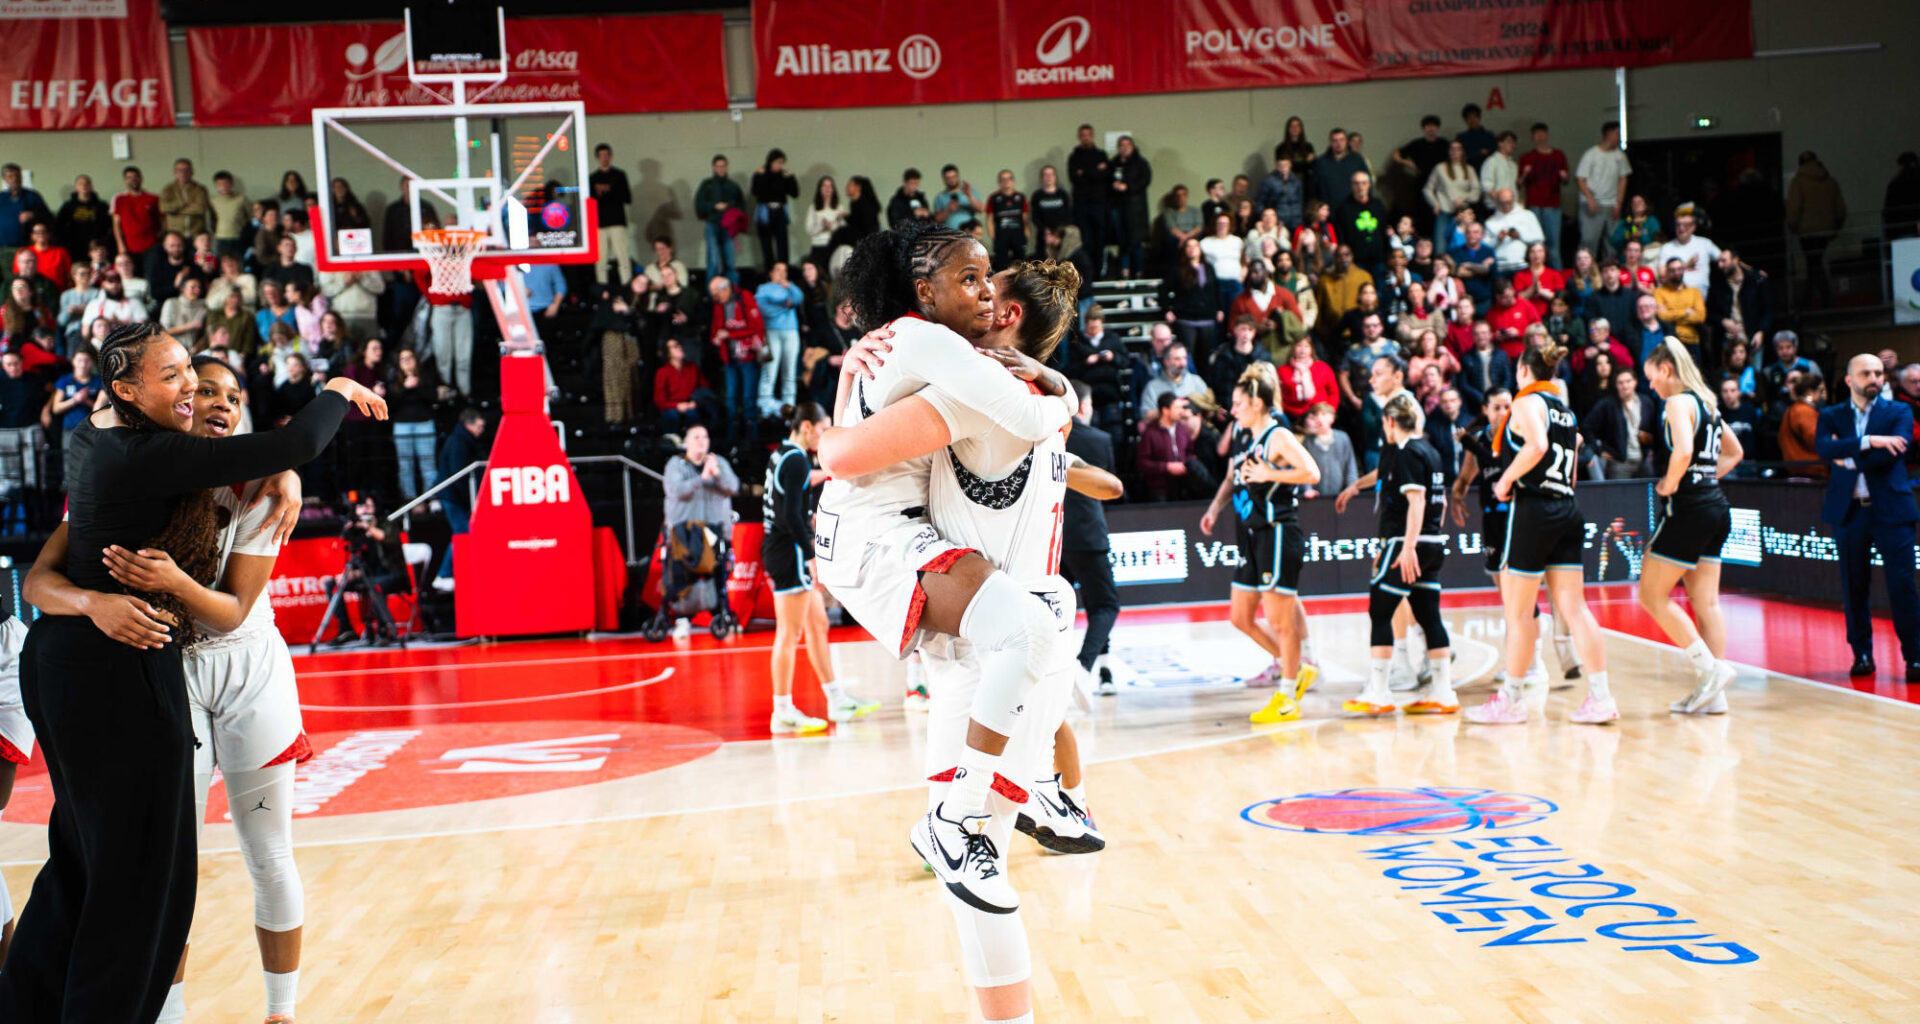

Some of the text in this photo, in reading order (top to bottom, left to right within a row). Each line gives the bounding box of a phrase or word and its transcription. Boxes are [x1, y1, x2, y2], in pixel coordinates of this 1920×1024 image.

[1500, 21, 1550, 39] 2024
[515, 49, 578, 70] d'Ascq
[774, 44, 893, 77] Allianz
[1016, 64, 1114, 85] DECATHLON
[10, 78, 159, 109] EIFFAGE
[1486, 87, 1505, 111] A
[1697, 423, 1723, 461] 16
[1545, 442, 1575, 485] 21
[490, 464, 570, 507] FIBA
[1357, 839, 1589, 949] WOMEN
[1449, 834, 1761, 966] EUROCUP
